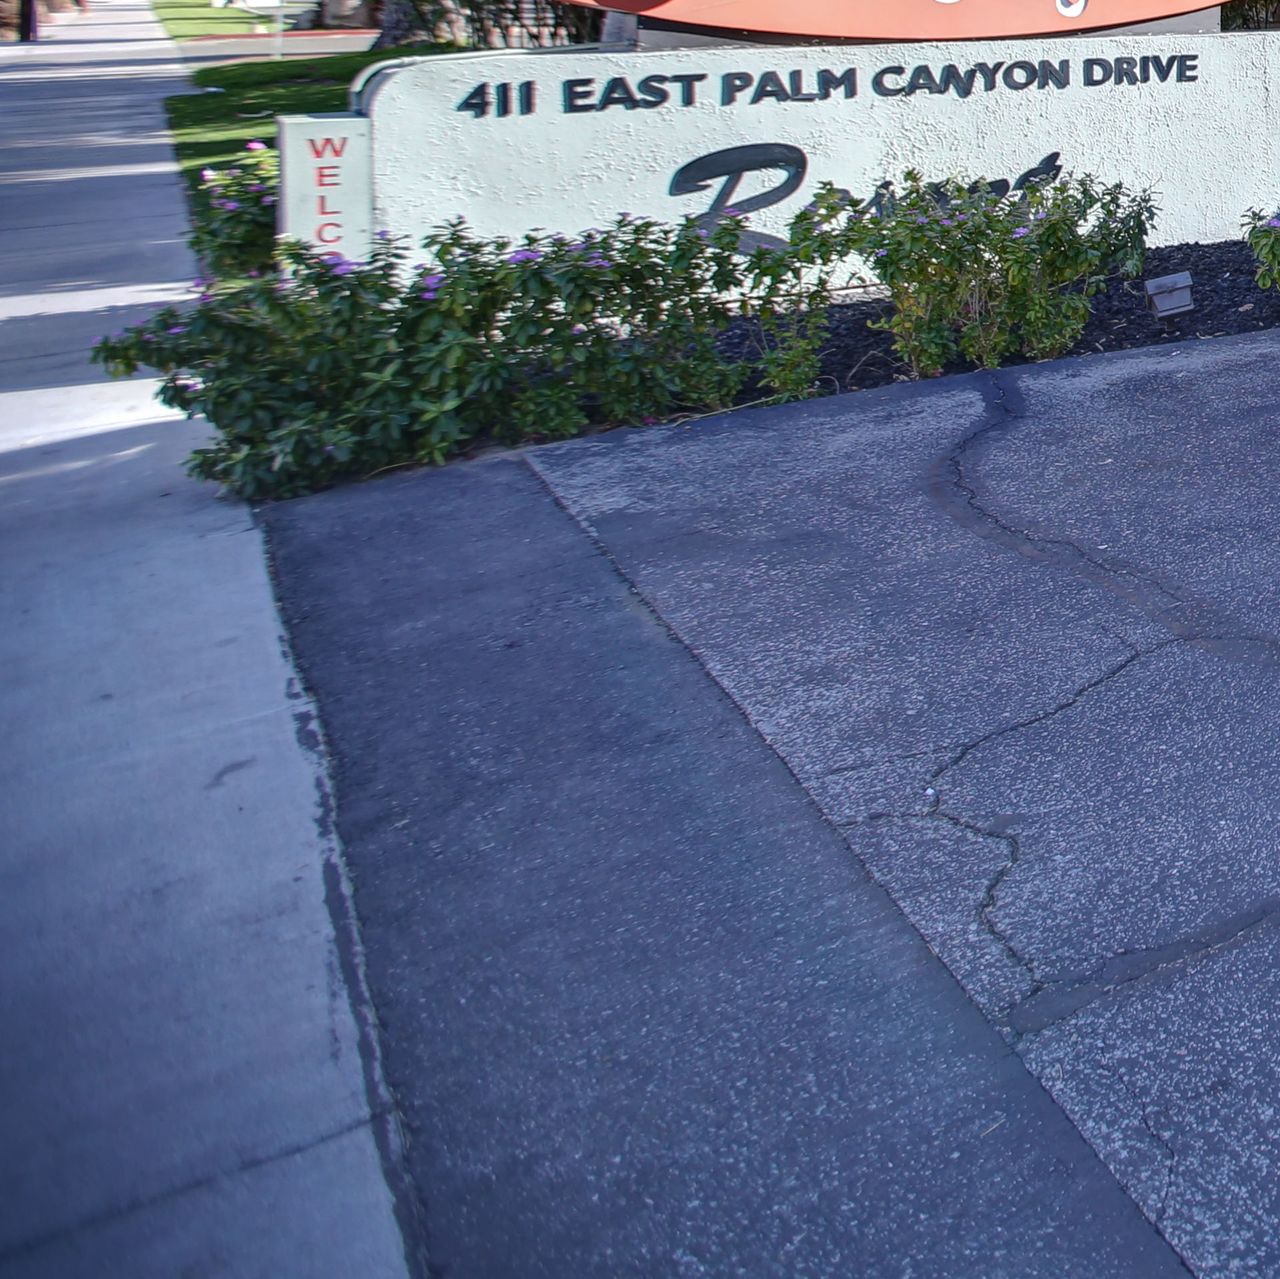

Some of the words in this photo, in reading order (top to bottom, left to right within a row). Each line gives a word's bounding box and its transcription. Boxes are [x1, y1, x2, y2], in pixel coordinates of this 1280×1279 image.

[456, 79, 537, 118] 411
[562, 72, 708, 114] EAST
[720, 66, 858, 106] PALM
[871, 58, 1071, 98] CANYON
[1082, 53, 1199, 87] DRIVE
[306, 136, 349, 258] WELC
